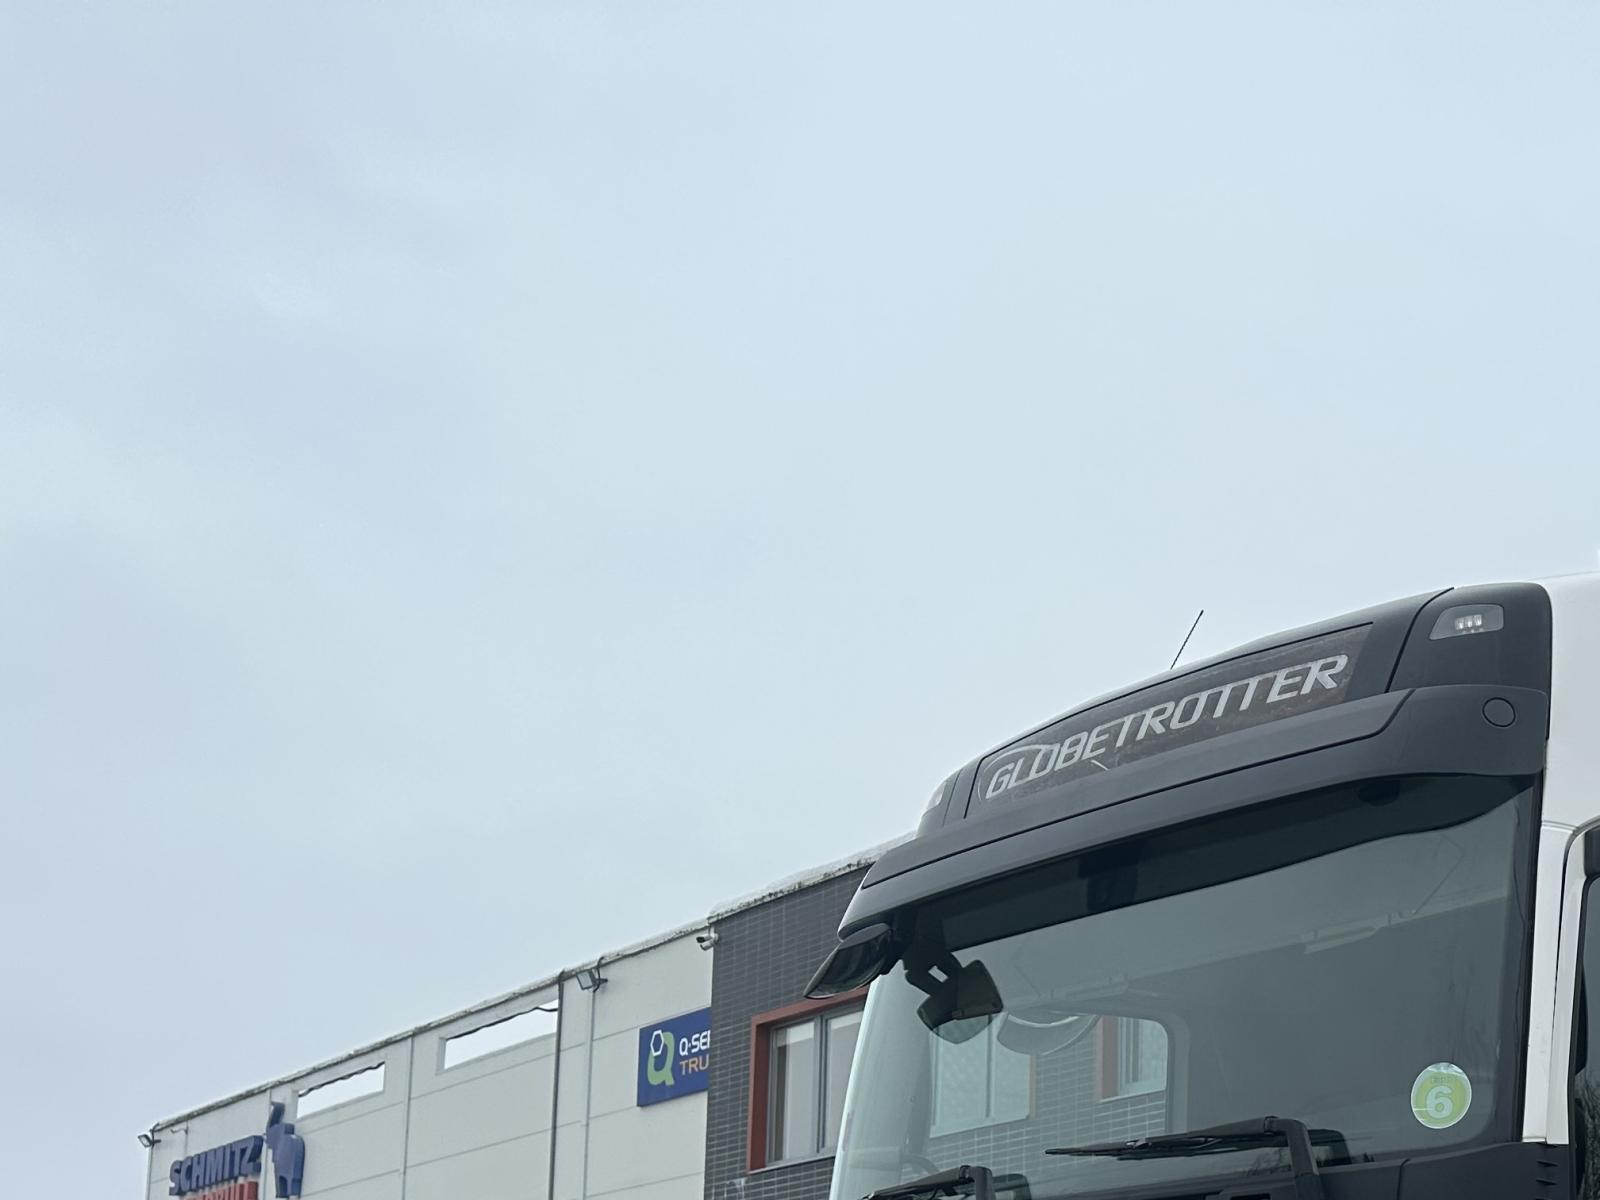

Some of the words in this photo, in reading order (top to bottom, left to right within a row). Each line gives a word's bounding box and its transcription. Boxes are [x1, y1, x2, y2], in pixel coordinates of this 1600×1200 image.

[985, 654, 1350, 800] GLOBETROTTER
[1426, 1085, 1453, 1119] 6
[169, 1135, 264, 1196] SCHMITZ
